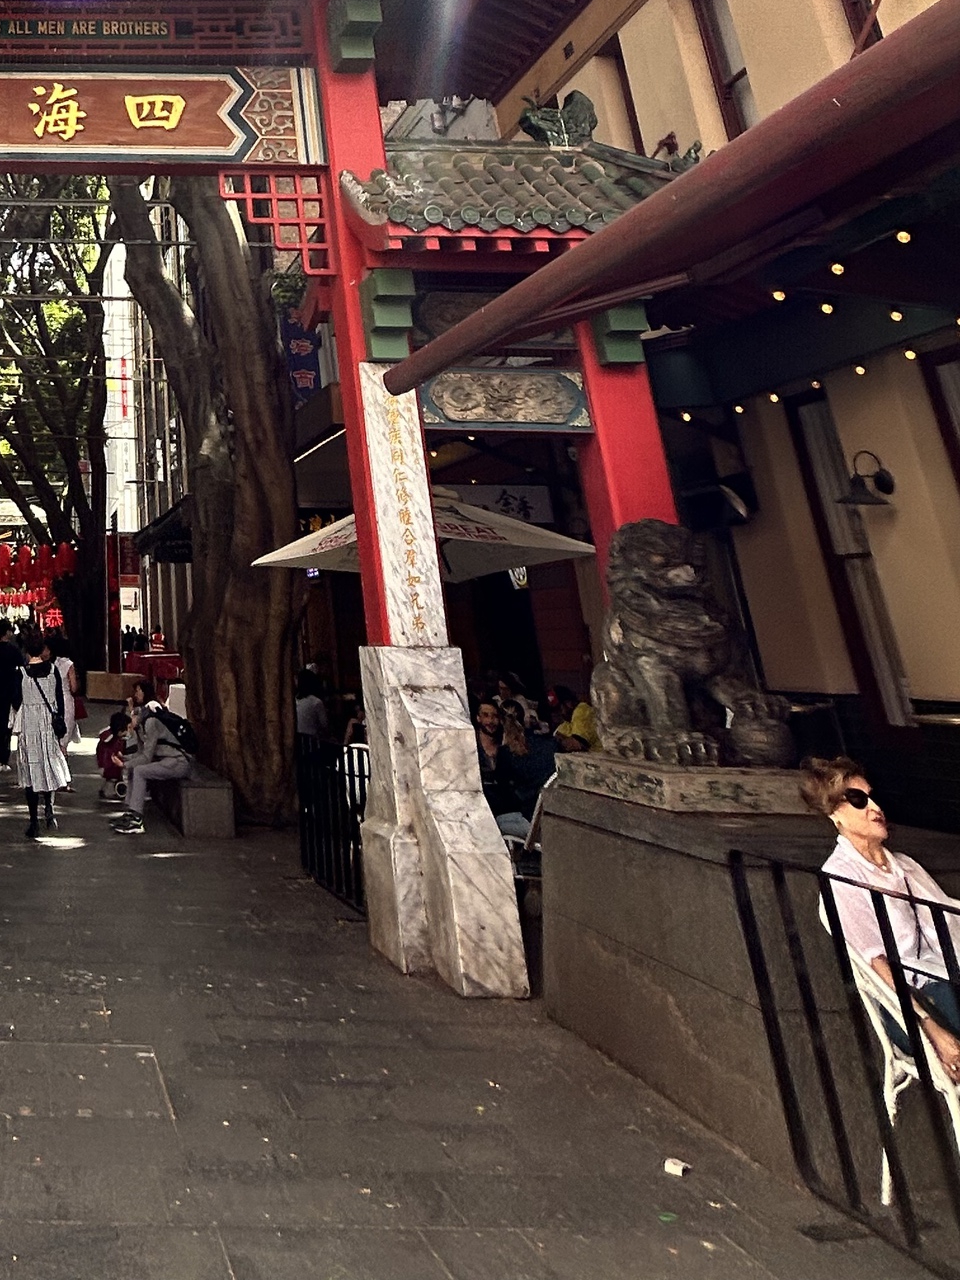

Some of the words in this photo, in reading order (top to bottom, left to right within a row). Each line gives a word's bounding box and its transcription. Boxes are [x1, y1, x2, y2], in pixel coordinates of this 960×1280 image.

[7, 20, 32, 35] ALL
[37, 20, 65, 35] MEN
[71, 21, 97, 35] ARE
[102, 21, 168, 35] BROTHERS
